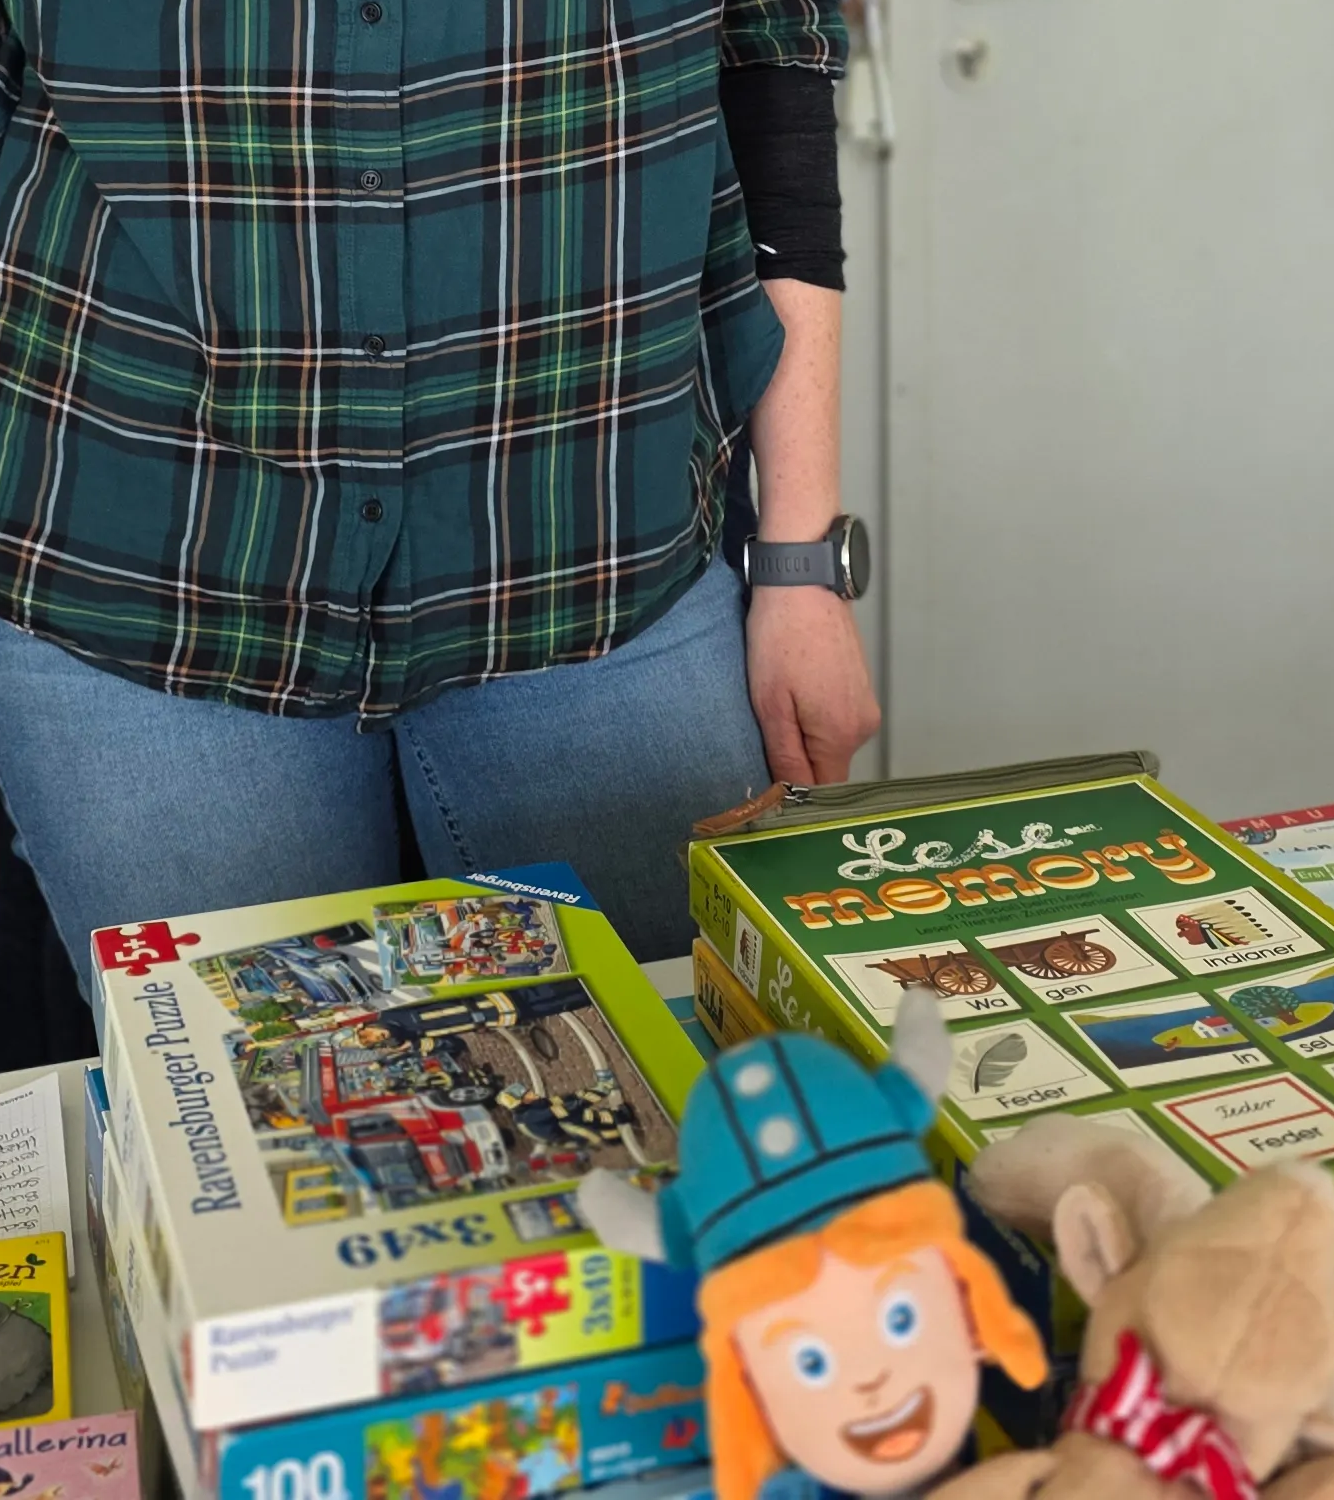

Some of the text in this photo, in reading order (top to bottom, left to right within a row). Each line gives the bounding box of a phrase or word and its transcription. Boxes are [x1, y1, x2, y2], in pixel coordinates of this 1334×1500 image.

[466, 873, 582, 903] Ravensburger
[782, 827, 1217, 931] memory
[115, 937, 160, 963] 5+
[1203, 943, 1298, 970] Indianer
[967, 994, 1009, 1012] Wa
[1045, 983, 1093, 1007] gen
[1232, 1050, 1259, 1067] In
[133, 980, 243, 1215] Ravensburger Puzzle
[997, 1083, 1069, 1110] Feder
[1249, 1121, 1324, 1154] Feder
[337, 1212, 497, 1270] 3x49
